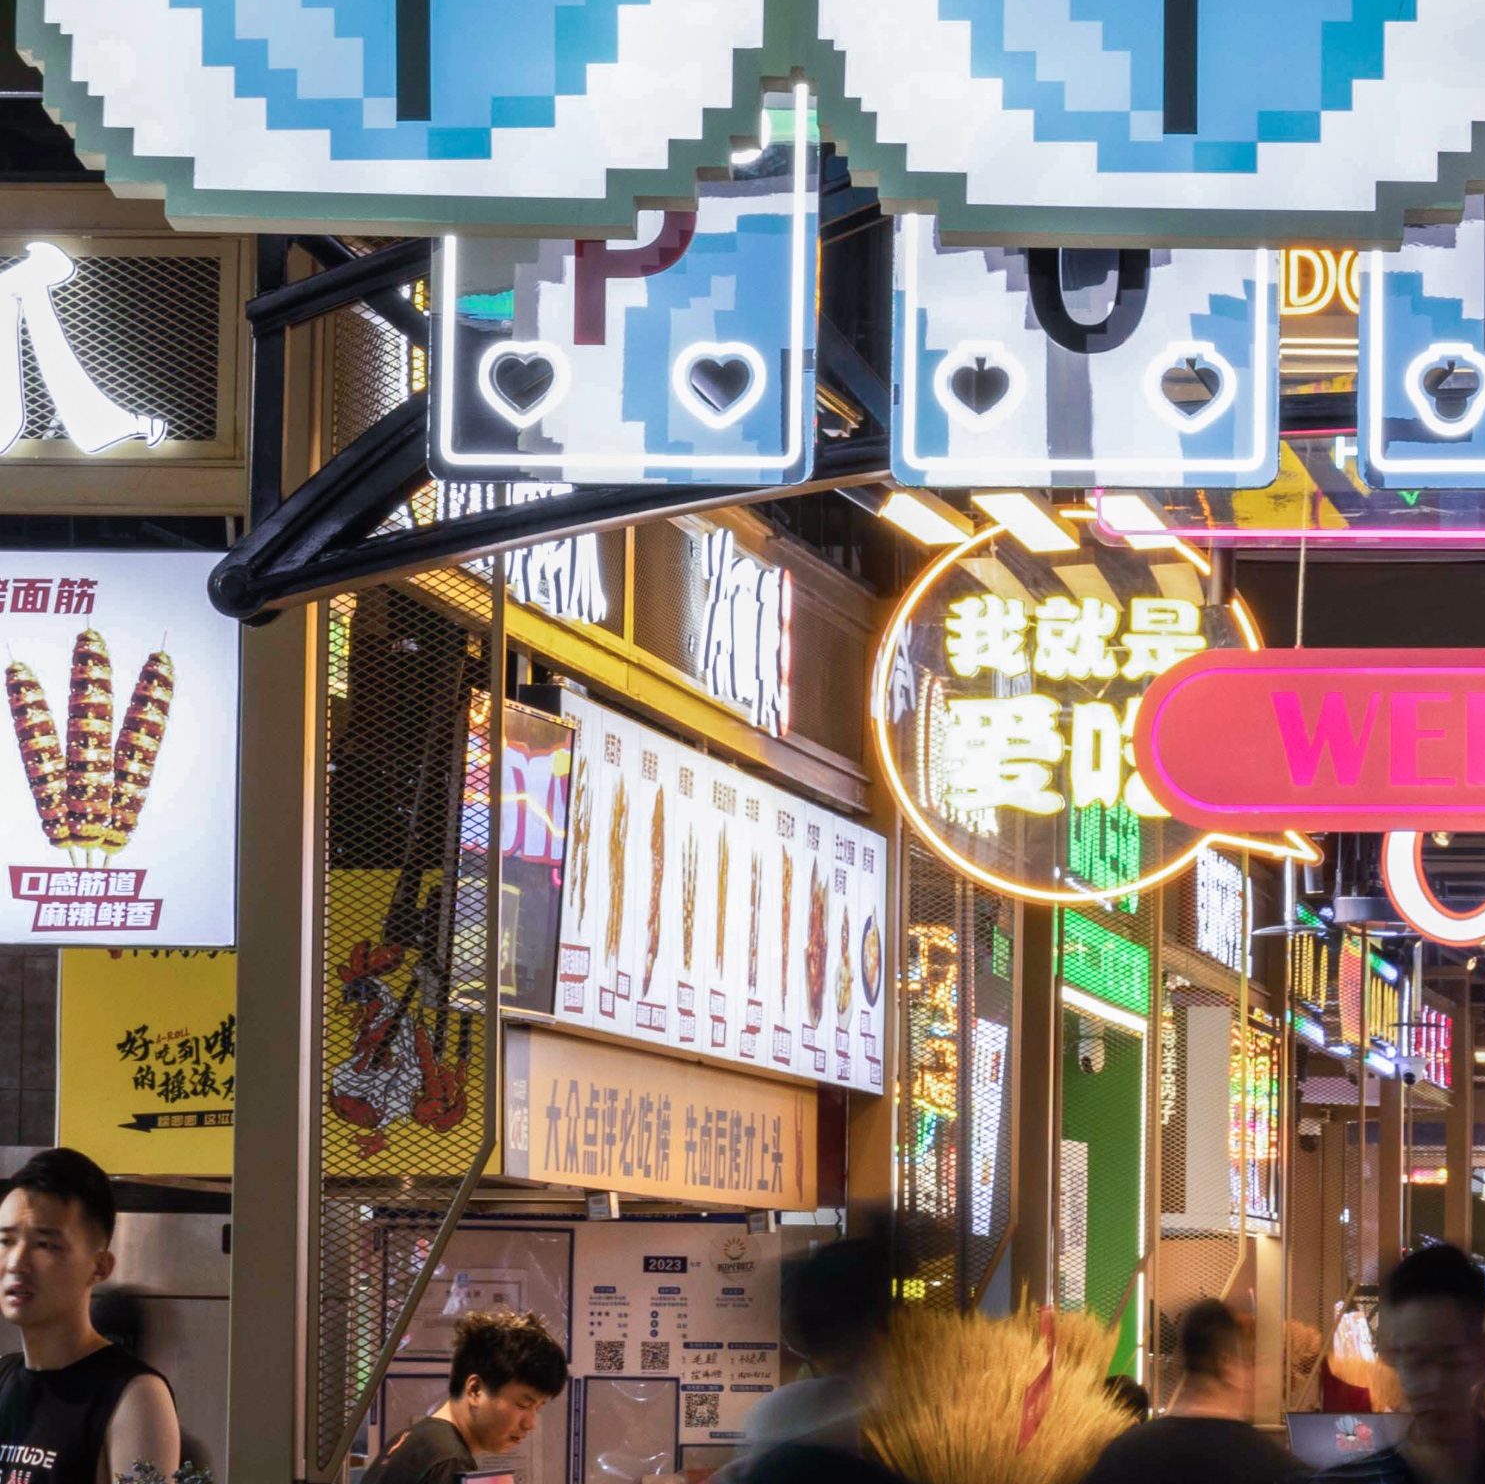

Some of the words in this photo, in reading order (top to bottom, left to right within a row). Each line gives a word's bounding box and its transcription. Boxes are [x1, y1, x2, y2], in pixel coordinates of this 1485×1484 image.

[944, 593, 1207, 681] 我就是
[19, 872, 138, 897] 口感筋道
[37, 901, 156, 928] 麻辣鲜香
[545, 1079, 671, 1181] 大众点评必吃榜
[684, 1104, 783, 1194] 先卤后烤才上头
[649, 1259, 682, 1271] 2023
